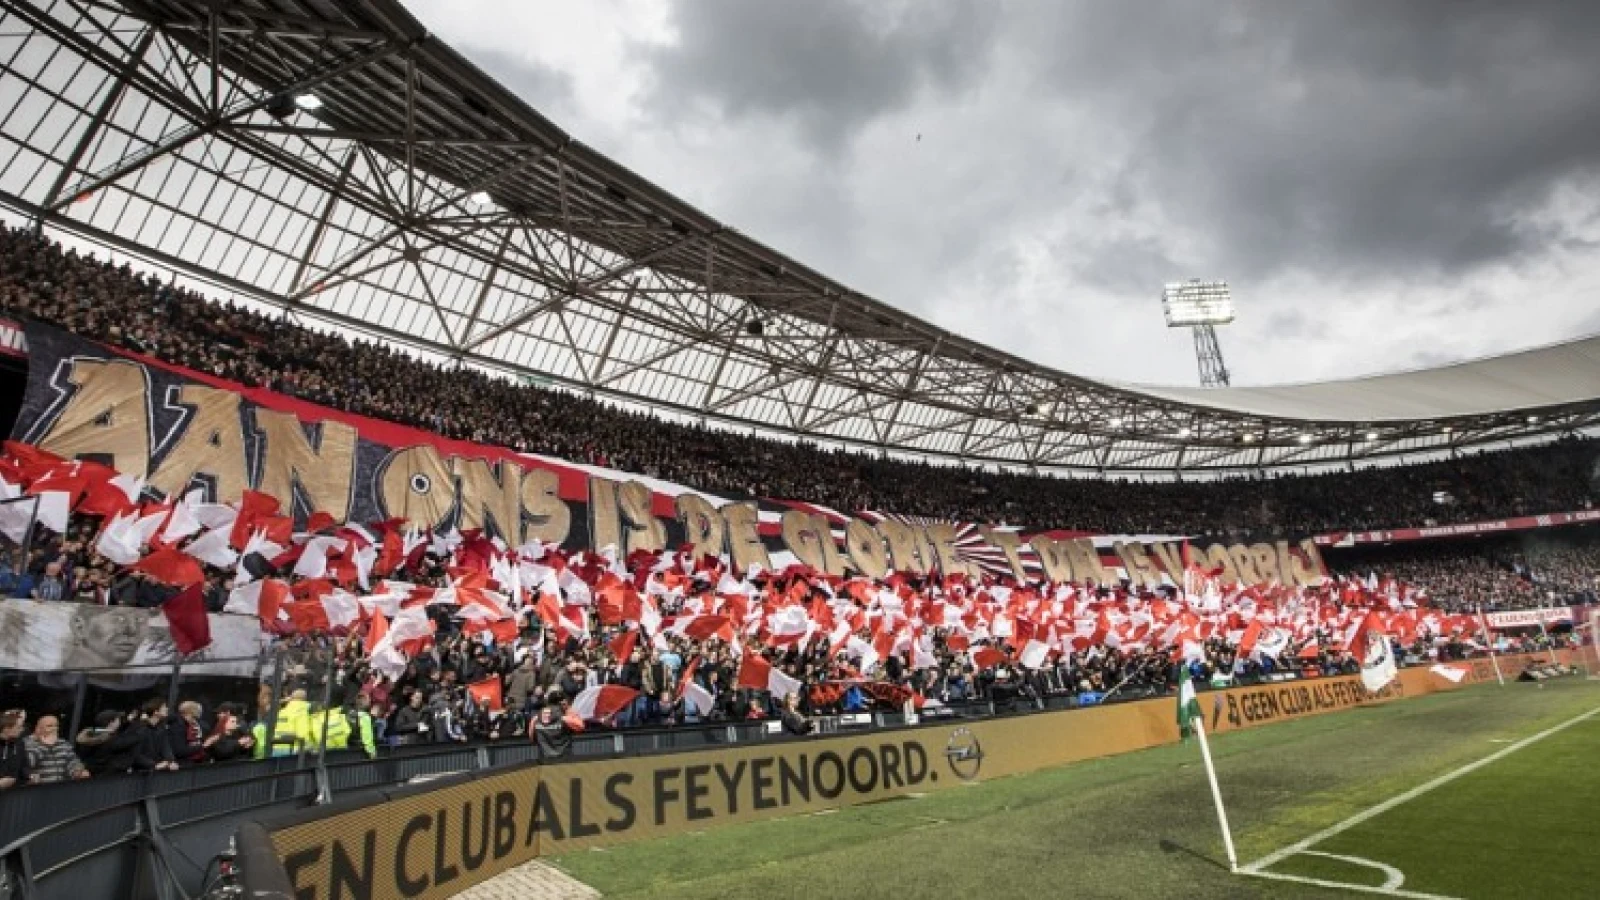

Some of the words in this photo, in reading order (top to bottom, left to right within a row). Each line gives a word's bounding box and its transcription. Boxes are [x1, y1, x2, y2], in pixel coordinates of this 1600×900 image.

[26, 357, 358, 525] AAN
[373, 446, 571, 549] ONS
[589, 476, 667, 558] IS
[676, 494, 773, 577] DE
[1240, 689, 1279, 722] GEEN
[1279, 686, 1312, 715] CLUB
[394, 790, 517, 898] CLUB
[525, 772, 637, 847] ALS
[653, 741, 938, 826] FEYENOORD.
